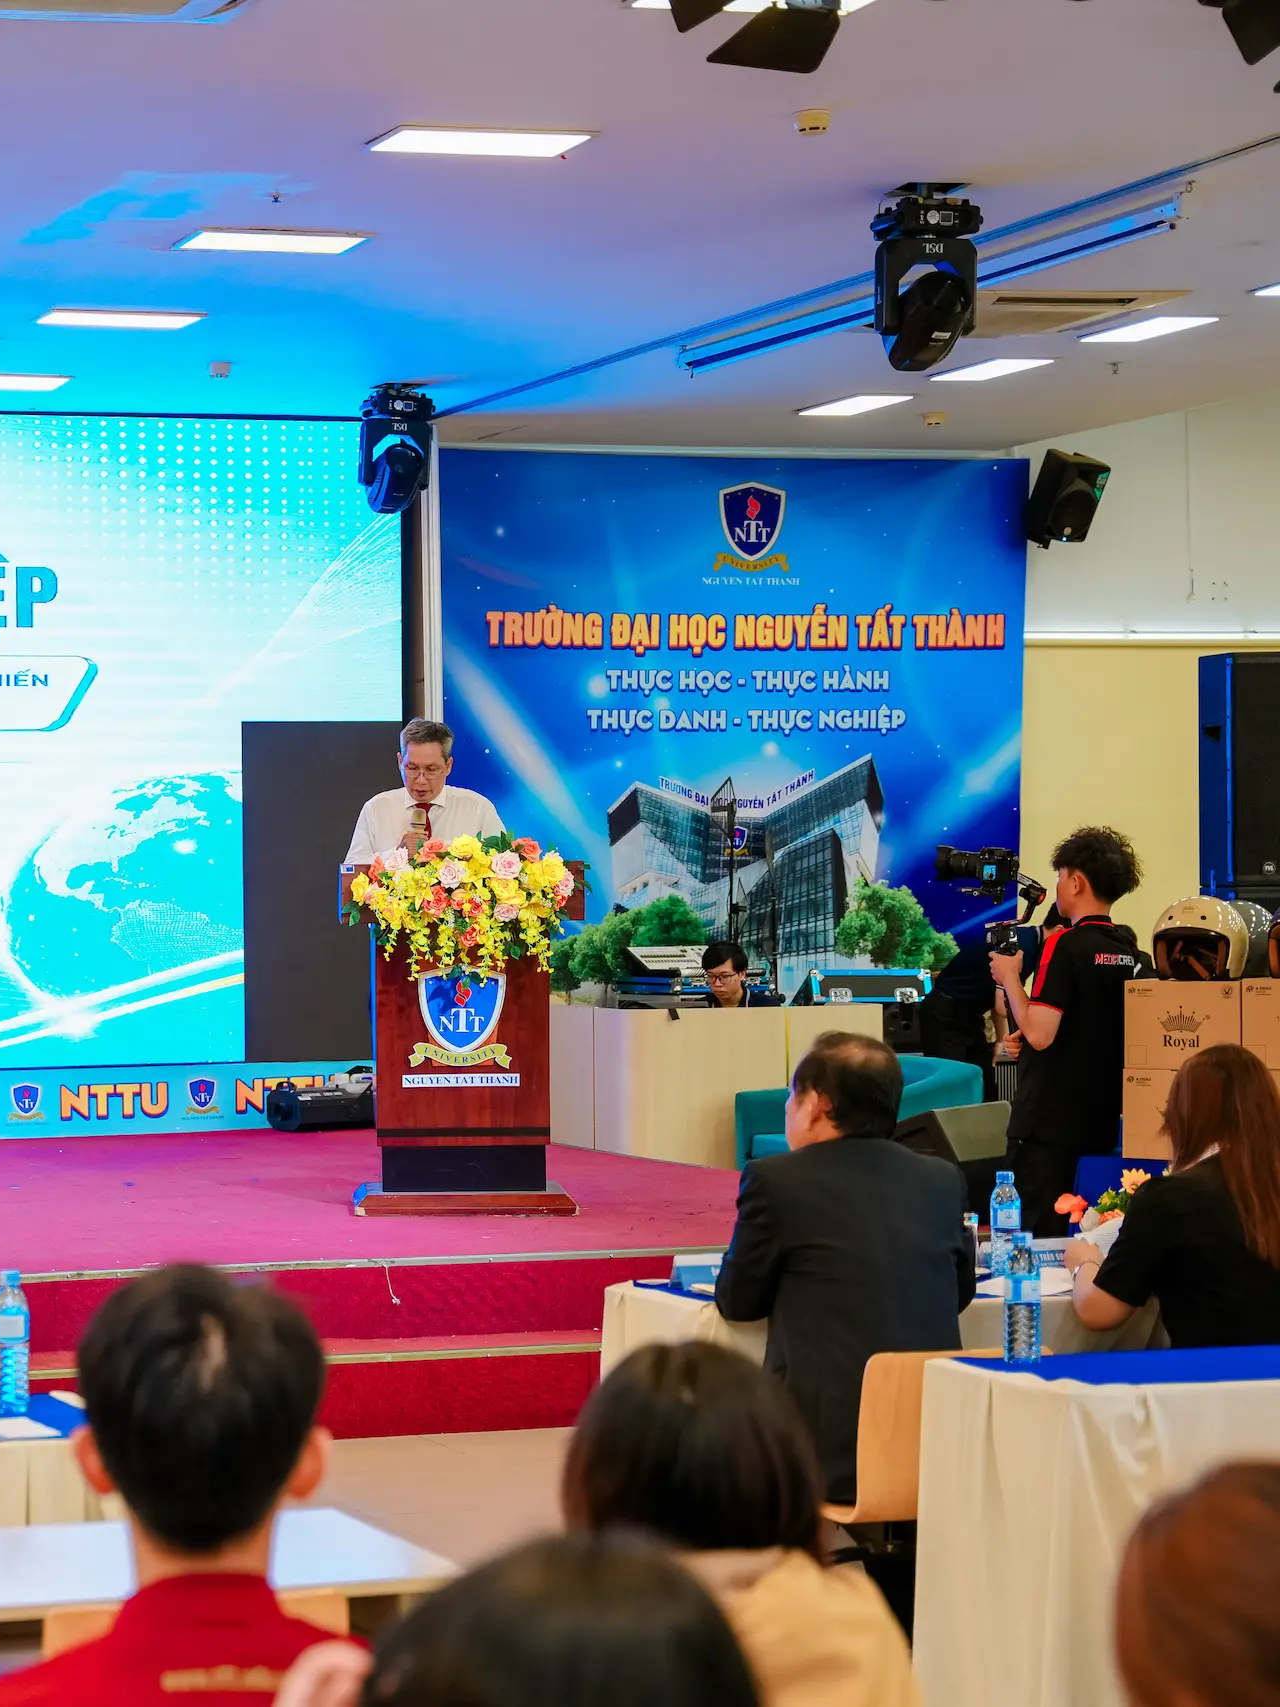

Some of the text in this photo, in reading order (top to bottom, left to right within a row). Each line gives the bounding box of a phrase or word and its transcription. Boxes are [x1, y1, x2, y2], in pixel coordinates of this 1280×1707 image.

[922, 243, 944, 253] DSL
[734, 520, 771, 543] NTT
[722, 555, 781, 570] UNIVERSITY
[702, 576, 800, 586] NGUYEN TAT THANH
[486, 603, 1005, 658] TRƯỜNG ĐẠI HỌC NGUYỄN TẤT THÀNH
[606, 669, 673, 698] THỰC
[679, 669, 732, 698] HỌC
[751, 669, 817, 697] THỰC
[822, 664, 890, 693] HÀNH
[587, 709, 654, 736] THỰC
[658, 709, 727, 733] DANH
[747, 709, 812, 737] THỰC
[818, 704, 907, 736] NGHIỆP
[439, 1007, 485, 1033] NTT
[1163, 1034, 1200, 1051] Royal
[423, 1047, 497, 1063] UNIVERSITY
[404, 1076, 518, 1085] NGUYEN TAT THANH
[60, 1081, 169, 1121] NTTU
[236, 1075, 336, 1114] NTT
